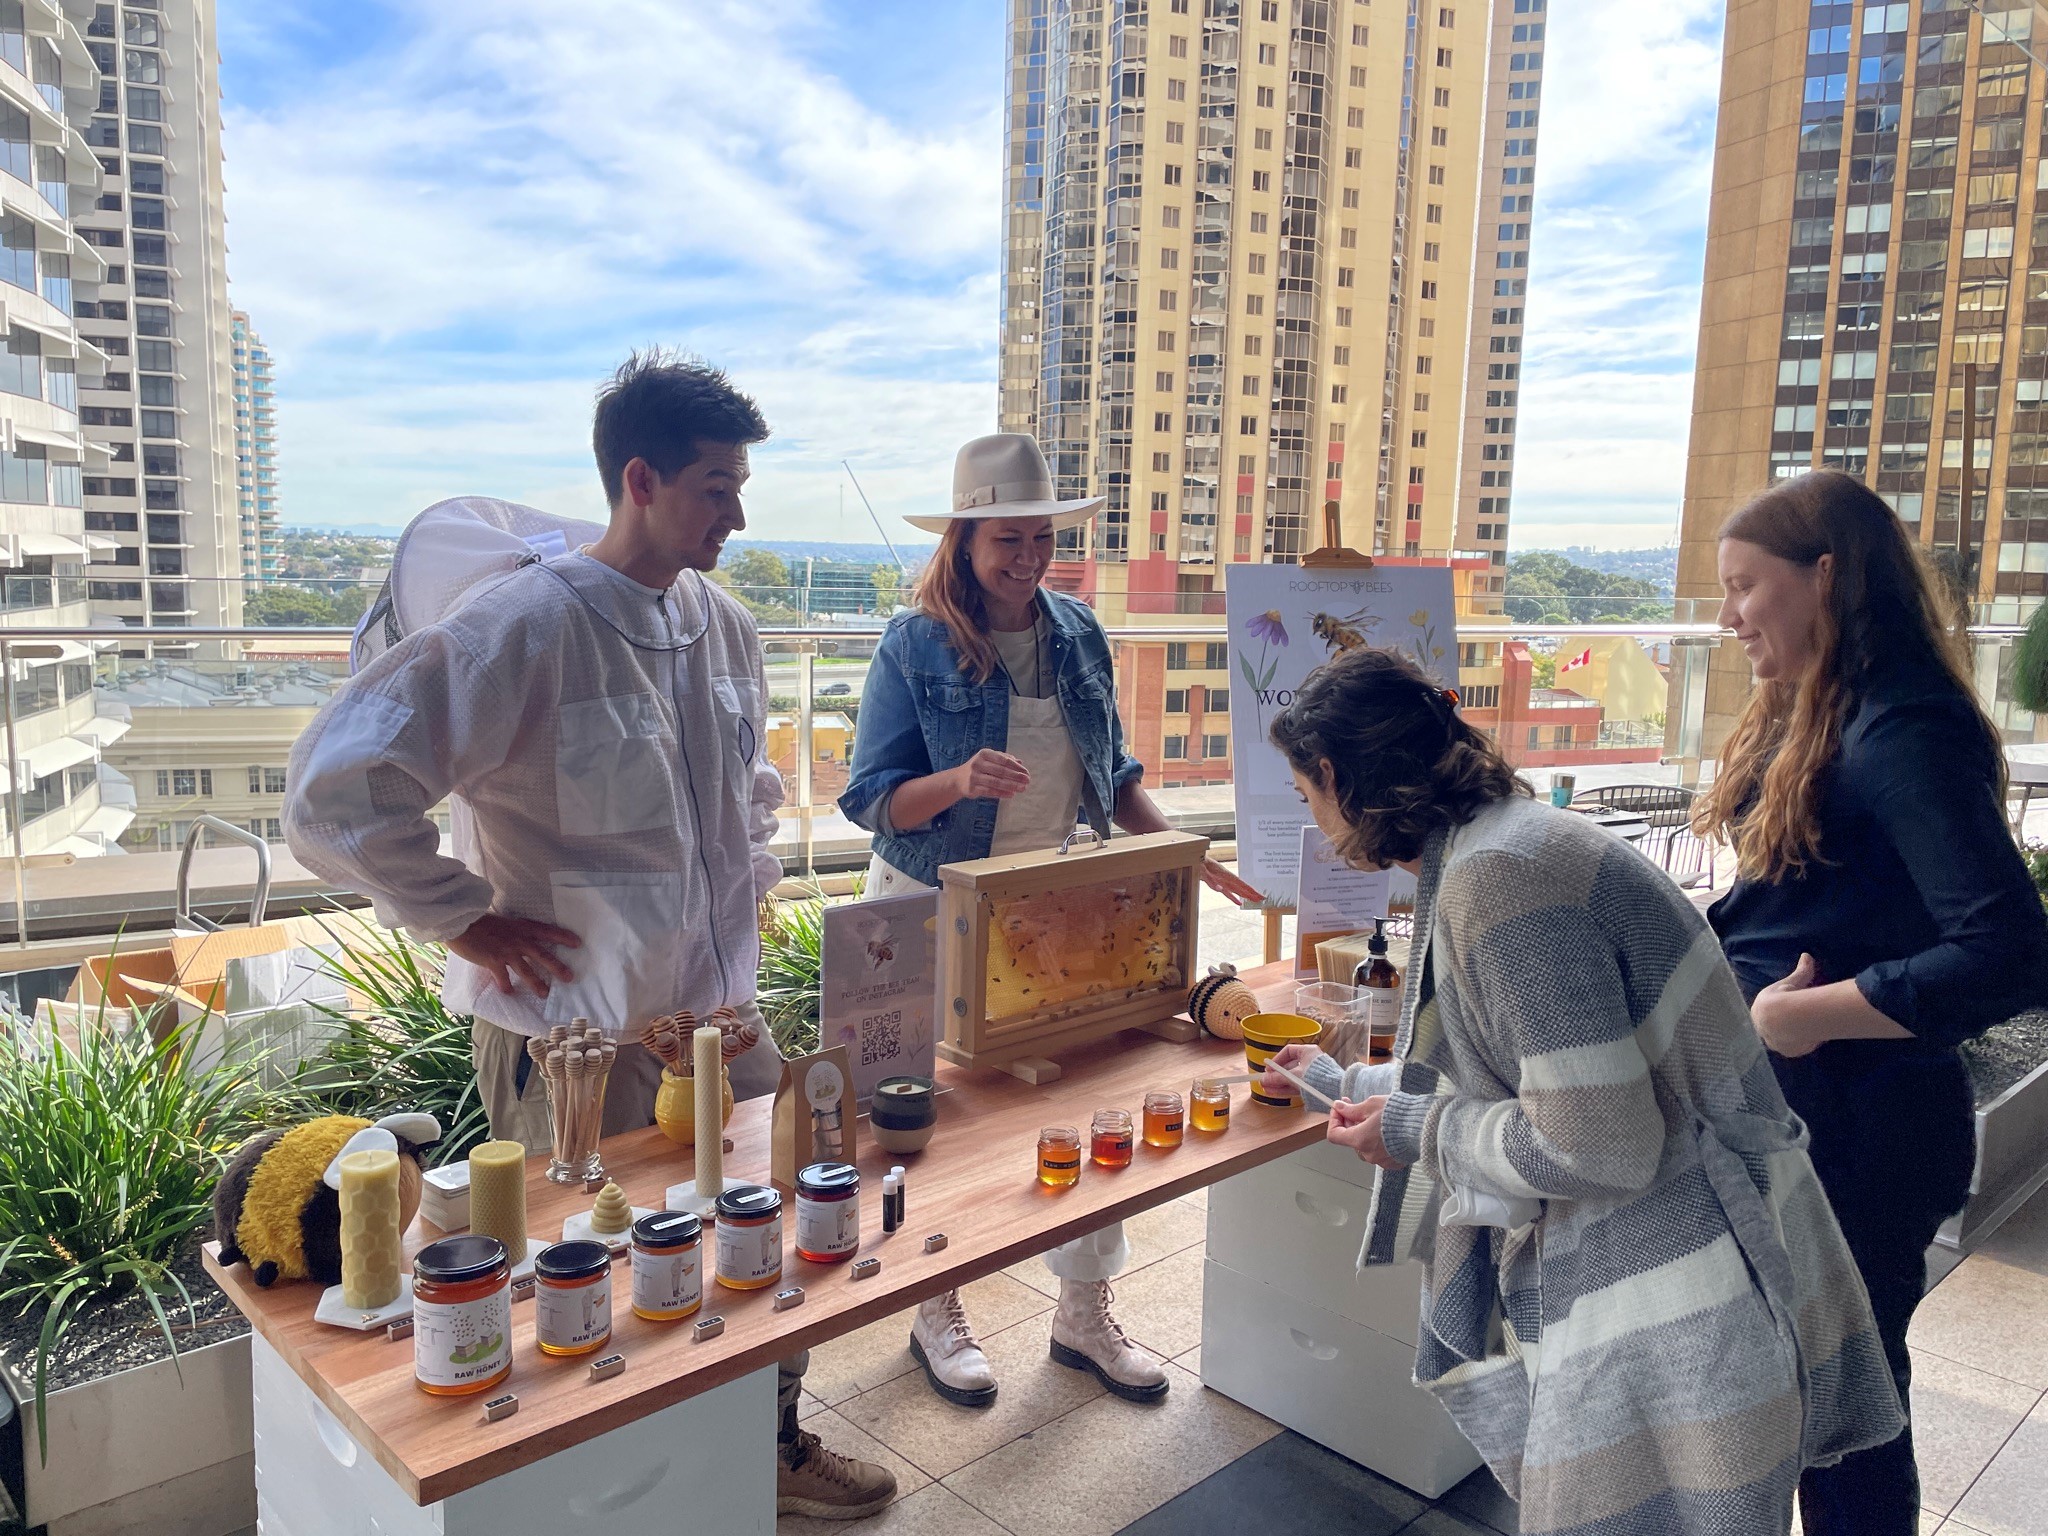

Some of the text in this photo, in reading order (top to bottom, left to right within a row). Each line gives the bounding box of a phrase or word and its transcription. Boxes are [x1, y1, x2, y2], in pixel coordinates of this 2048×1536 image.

[1289, 580, 1393, 593] ROOFTOP BEES
[1255, 689, 1298, 706] WO
[841, 975, 920, 999] FOLLOW THE BEE TEAM
[856, 987, 906, 1003] ON INSTAGRAM
[827, 1242, 843, 1250] RAW
[751, 1268, 767, 1277] RAW
[661, 1292, 699, 1308] RAW HONEY
[572, 1323, 610, 1343] RAW HONEY
[454, 1368, 474, 1379] RAW
[476, 1359, 501, 1375] HONEY
